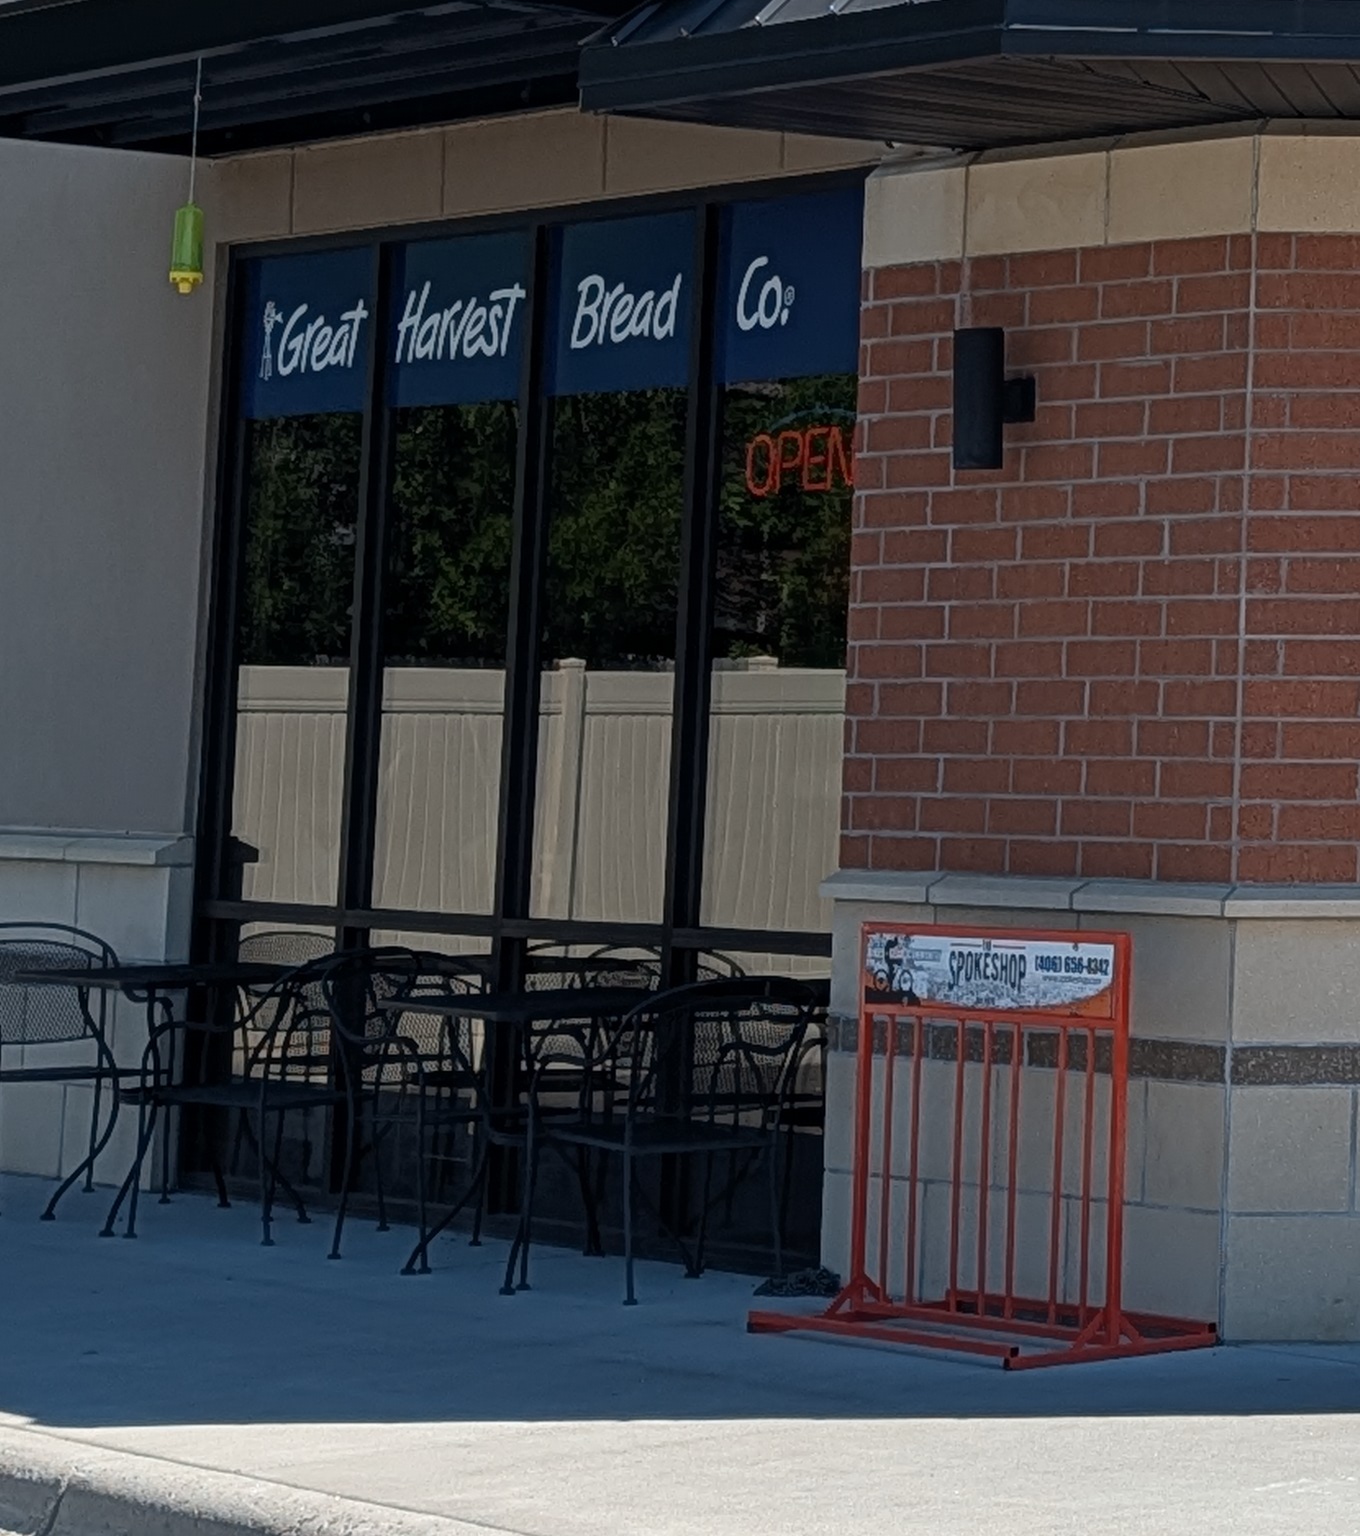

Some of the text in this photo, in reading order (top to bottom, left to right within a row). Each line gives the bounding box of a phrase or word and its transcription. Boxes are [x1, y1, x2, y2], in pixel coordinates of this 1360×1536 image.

[277, 299, 368, 376] Great
[395, 280, 527, 364] Harvest
[570, 273, 682, 349] Bread
[746, 426, 854, 496] OPEN
[949, 950, 1027, 993] SPOKESHOP
[1034, 954, 1062, 973] (406)
